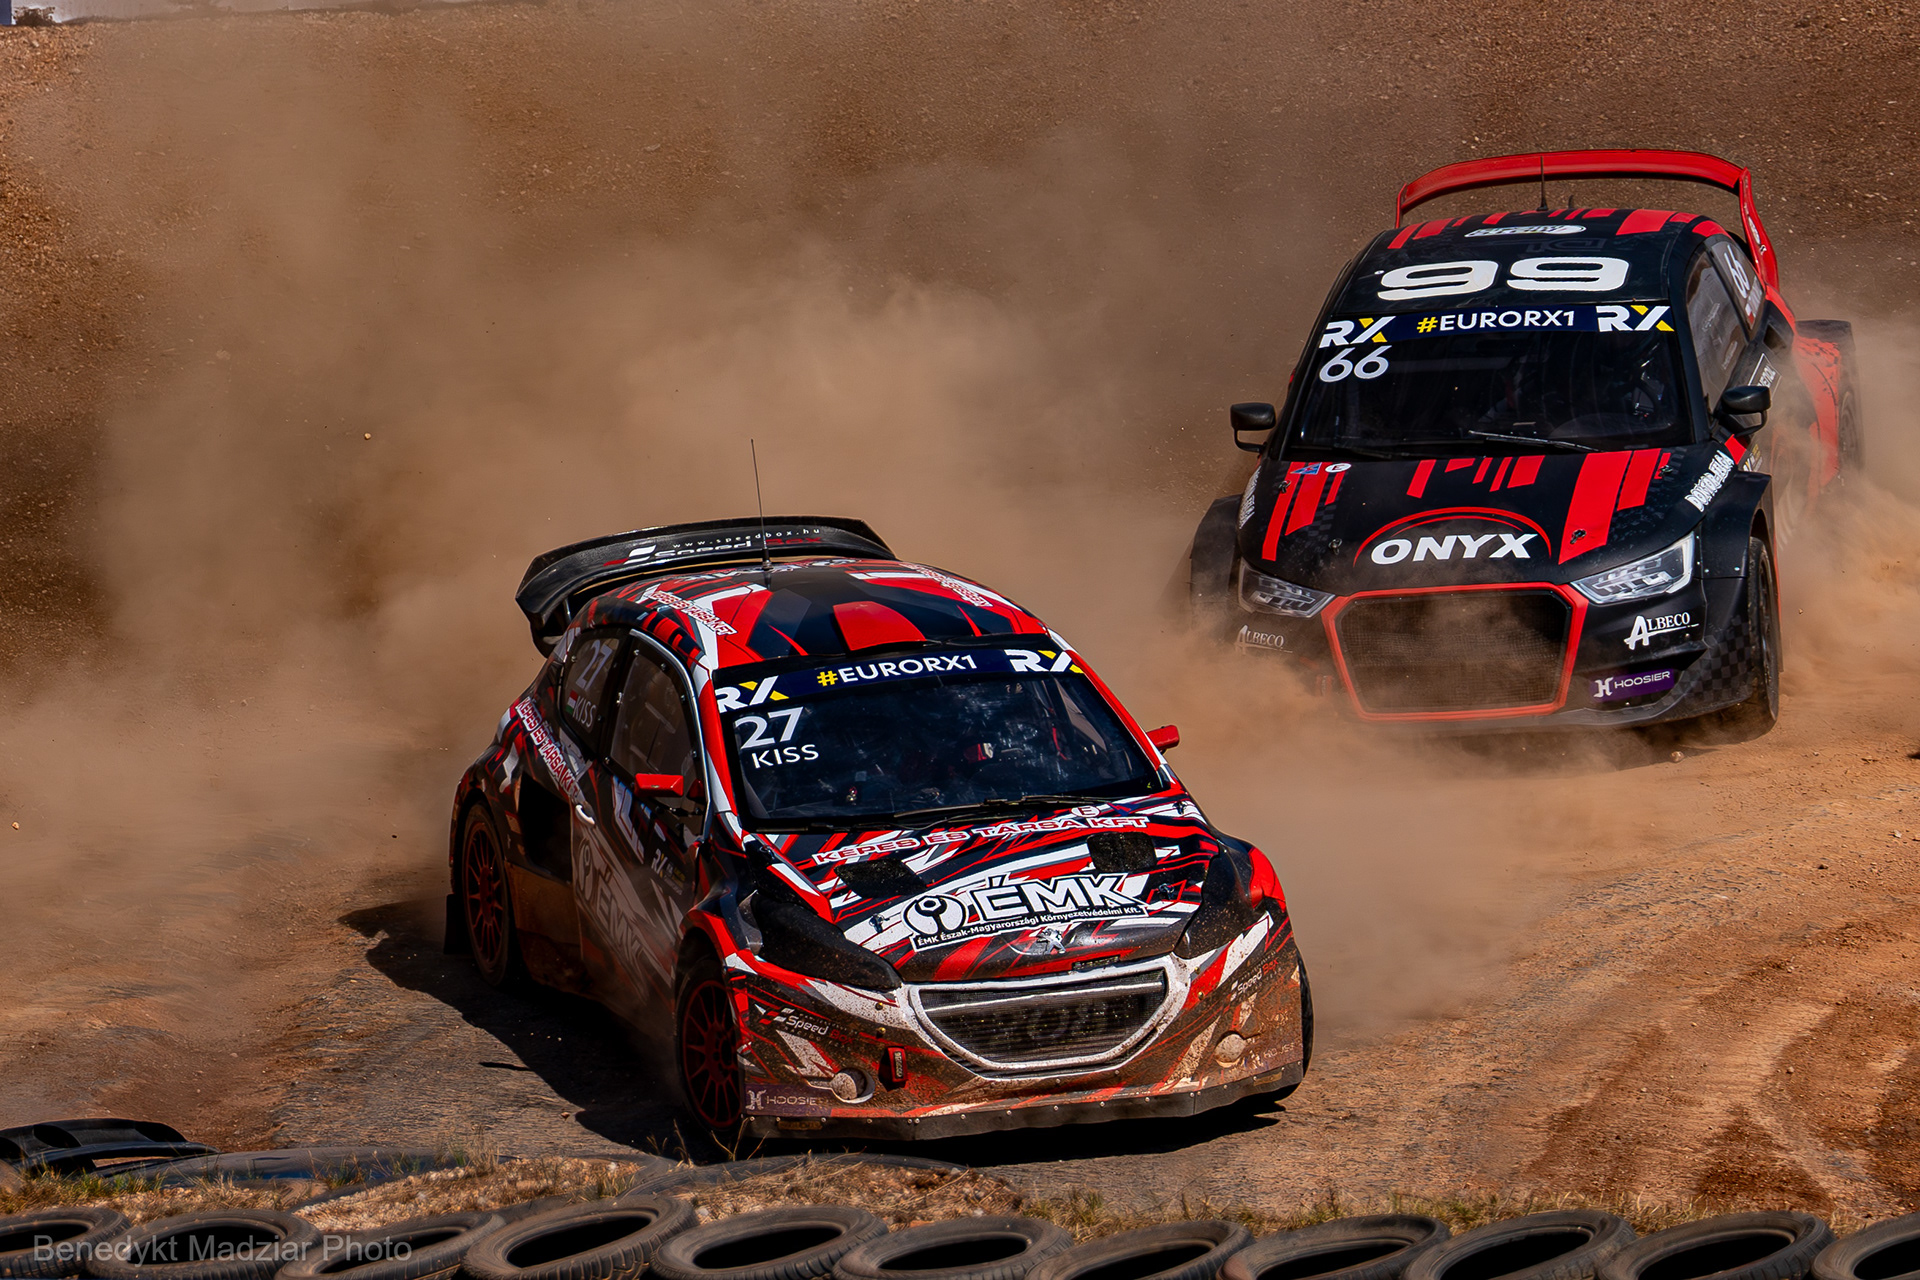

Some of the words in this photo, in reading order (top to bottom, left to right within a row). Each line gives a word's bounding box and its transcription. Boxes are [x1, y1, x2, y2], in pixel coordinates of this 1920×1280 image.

[1319, 315, 1397, 349] RX
[1416, 309, 1575, 333] #EURORX1
[1595, 304, 1676, 332] RX
[1319, 345, 1393, 383] 66
[673, 527, 821, 549] www.speedbox.hu
[1370, 533, 1539, 565] ONYX
[1234, 624, 1286, 655] ALBECO
[1624, 611, 1691, 650] ALBECO
[575, 639, 613, 691] 27
[714, 676, 790, 714] RX
[816, 655, 978, 687] #EURORX1
[1004, 649, 1085, 673] RX
[1614, 670, 1671, 689] HOOSIER
[572, 696, 597, 729] KISS
[734, 706, 804, 749] 27
[751, 743, 820, 769] KISS
[1089, 816, 1147, 829] KFT
[973, 873, 1138, 920] ÉMK
[917, 936, 940, 946] ÉMK
[940, 916, 1040, 941] Észak-Magyarországi
[1040, 908, 1122, 923] Környezetvédelmi
[1123, 906, 1142, 914] Kft.
[785, 1015, 829, 1035] Speed
[830, 1029, 854, 1045] Box
[766, 1095, 830, 1106] HOOSIE
